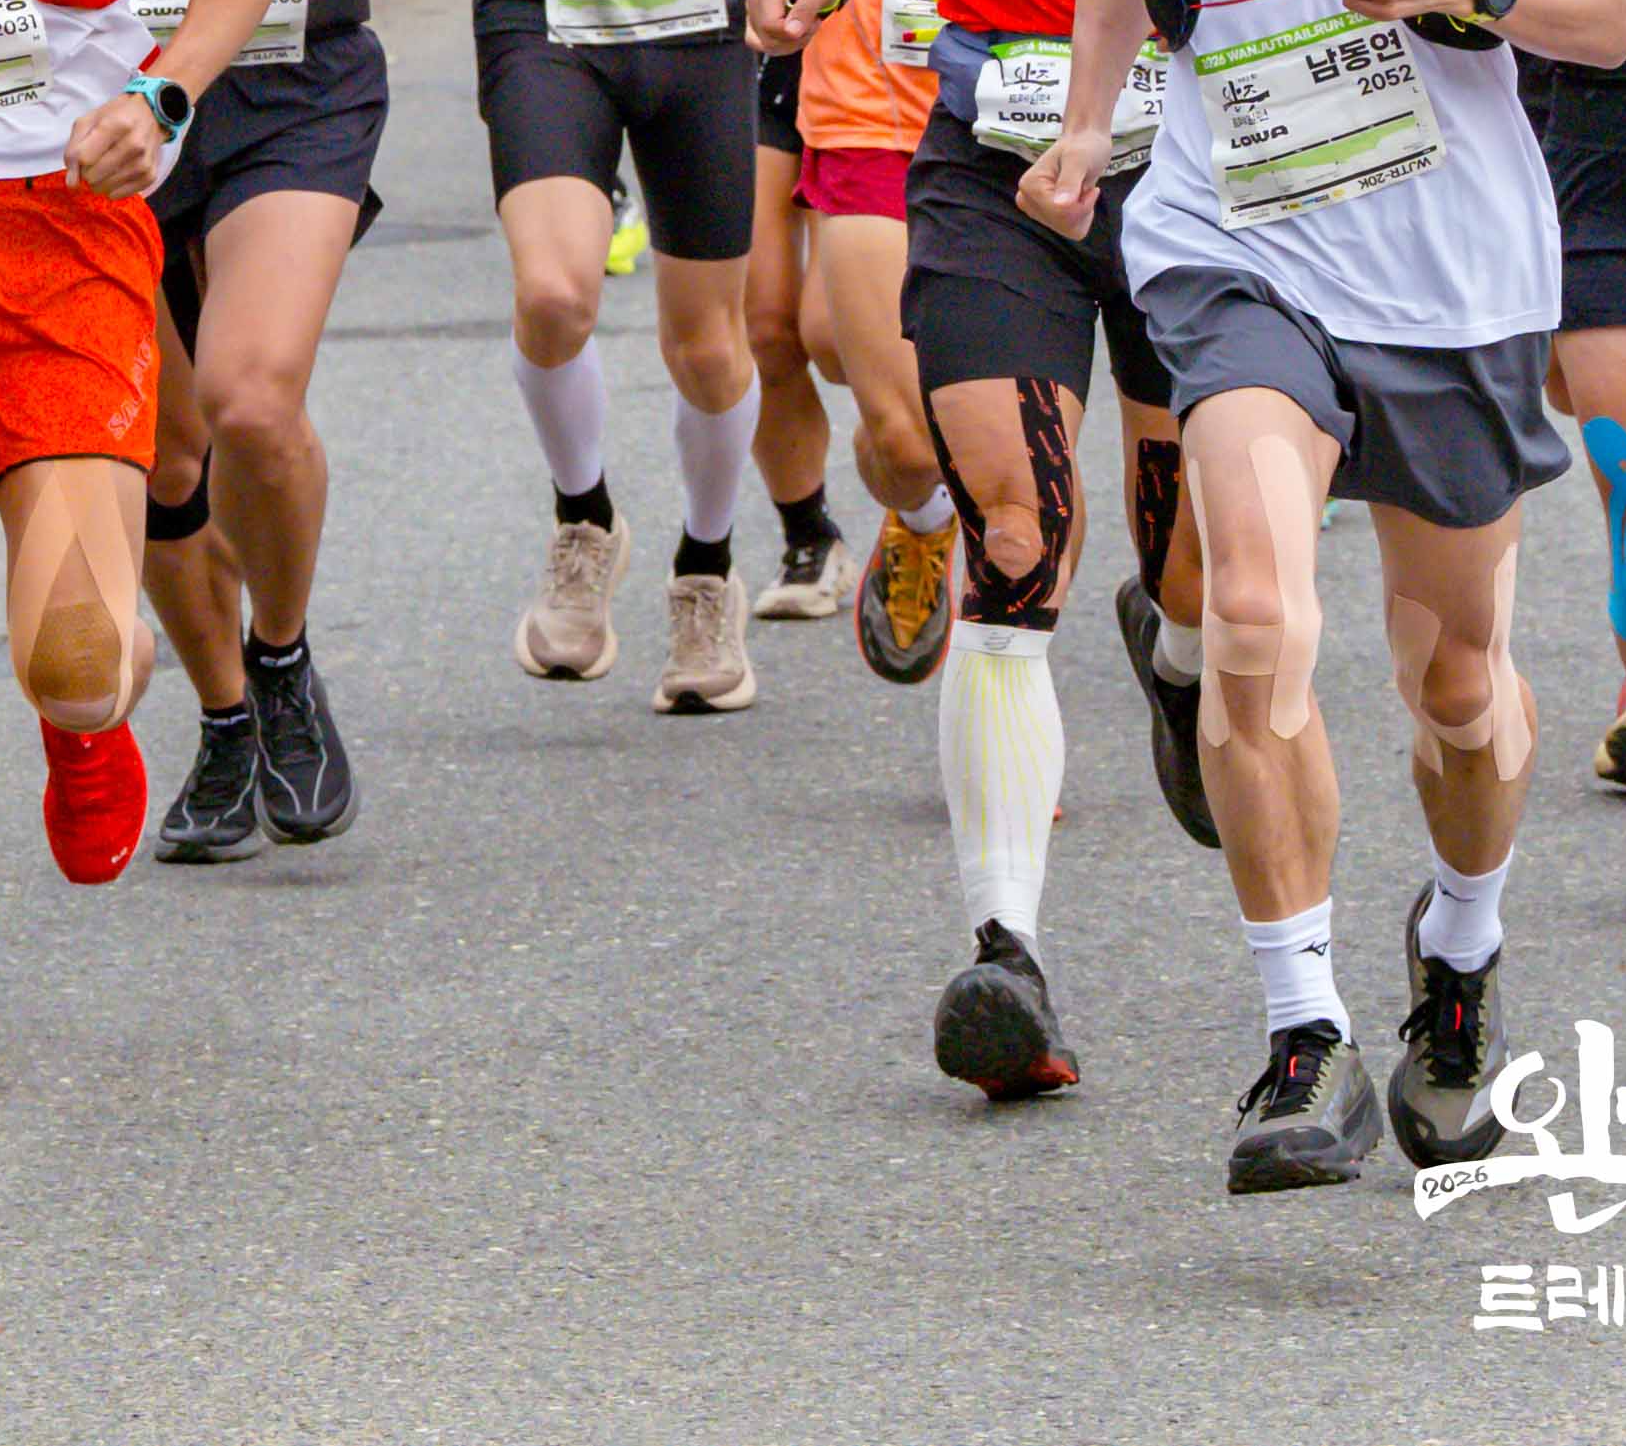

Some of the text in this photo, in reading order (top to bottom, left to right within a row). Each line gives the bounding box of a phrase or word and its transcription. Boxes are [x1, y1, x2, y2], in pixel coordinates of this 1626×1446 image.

[132, 6, 187, 17] OWA
[1226, 18, 1346, 63] WANJUTRAILRUN
[1305, 27, 1406, 85] 남동연
[1356, 64, 1416, 97] 2052
[998, 110, 1063, 125] LOWA
[1143, 98, 1163, 116] 21
[1230, 124, 1289, 151] LOWA
[1357, 156, 1433, 191] WJTR-20K
